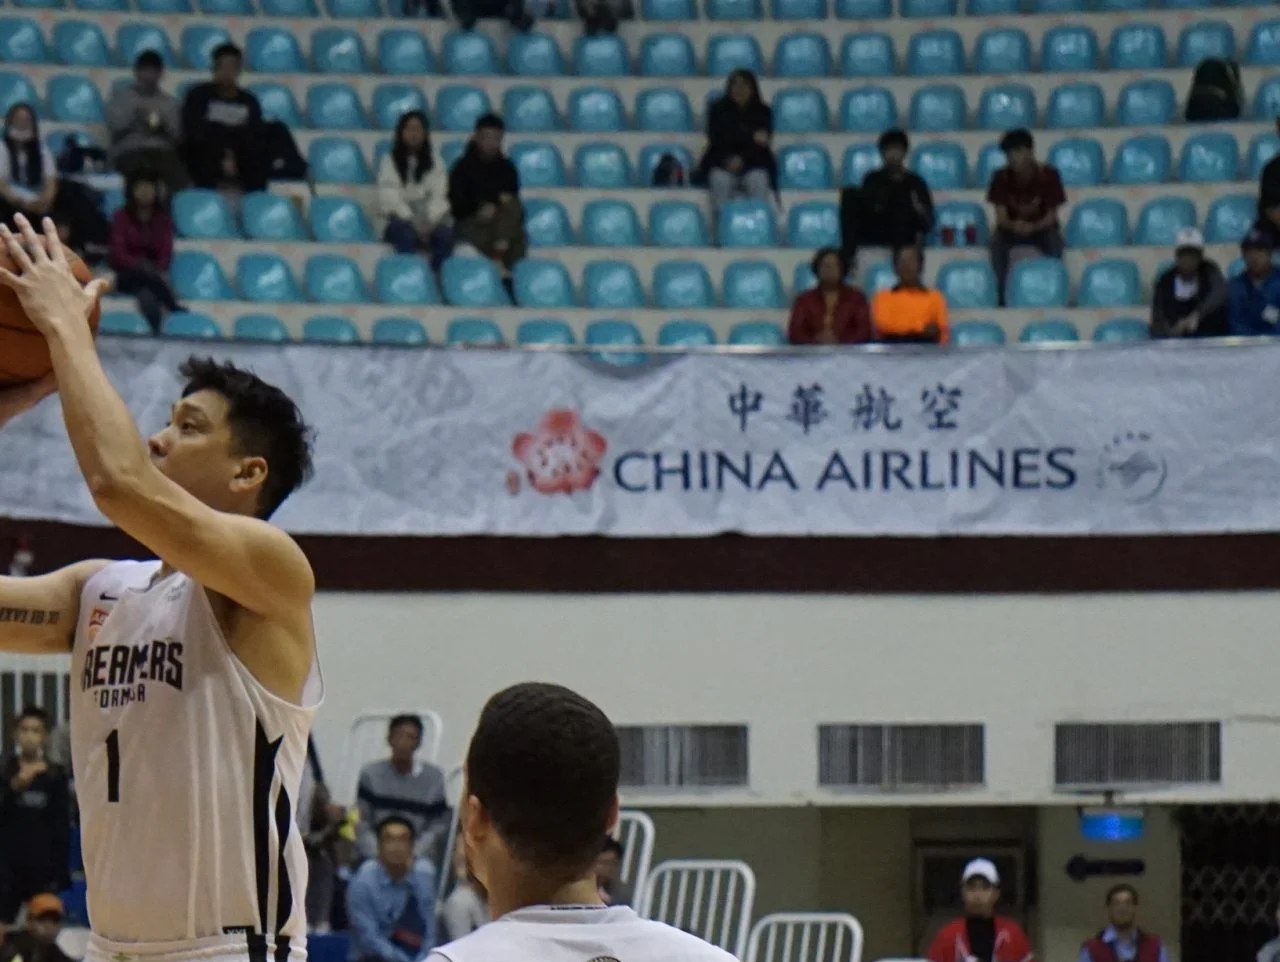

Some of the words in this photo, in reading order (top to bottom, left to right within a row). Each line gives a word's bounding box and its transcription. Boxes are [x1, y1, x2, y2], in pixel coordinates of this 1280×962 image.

[726, 382, 963, 435] 中華航空
[613, 450, 799, 493] CHINA
[815, 446, 1078, 492] AIRLINES
[83, 639, 184, 692] REAMRS
[94, 682, 146, 709] ORMA
[105, 728, 120, 803] 1
